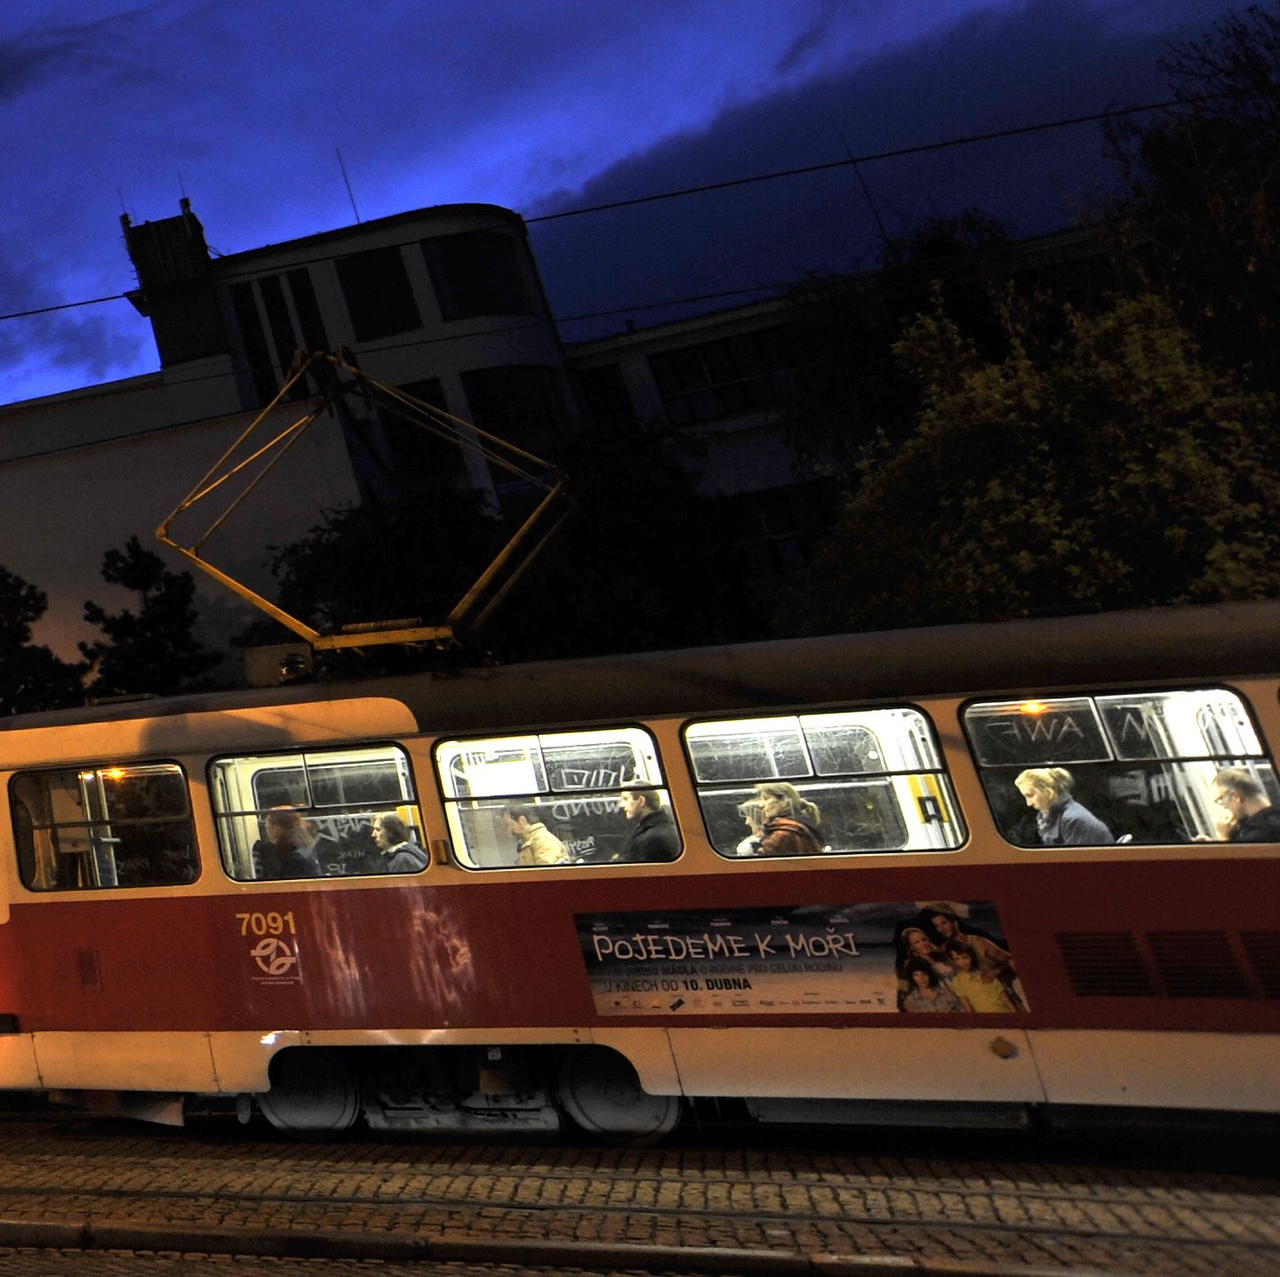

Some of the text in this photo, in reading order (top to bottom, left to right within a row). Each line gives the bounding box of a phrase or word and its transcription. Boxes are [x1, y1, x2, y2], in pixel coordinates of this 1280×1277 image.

[235, 911, 296, 936] 7091
[592, 927, 861, 962] POJEDEME K MOŘI
[615, 979, 658, 992] KINECH
[661, 979, 679, 991] OD
[682, 979, 704, 991] 10.
[706, 978, 752, 991] DUBNA
